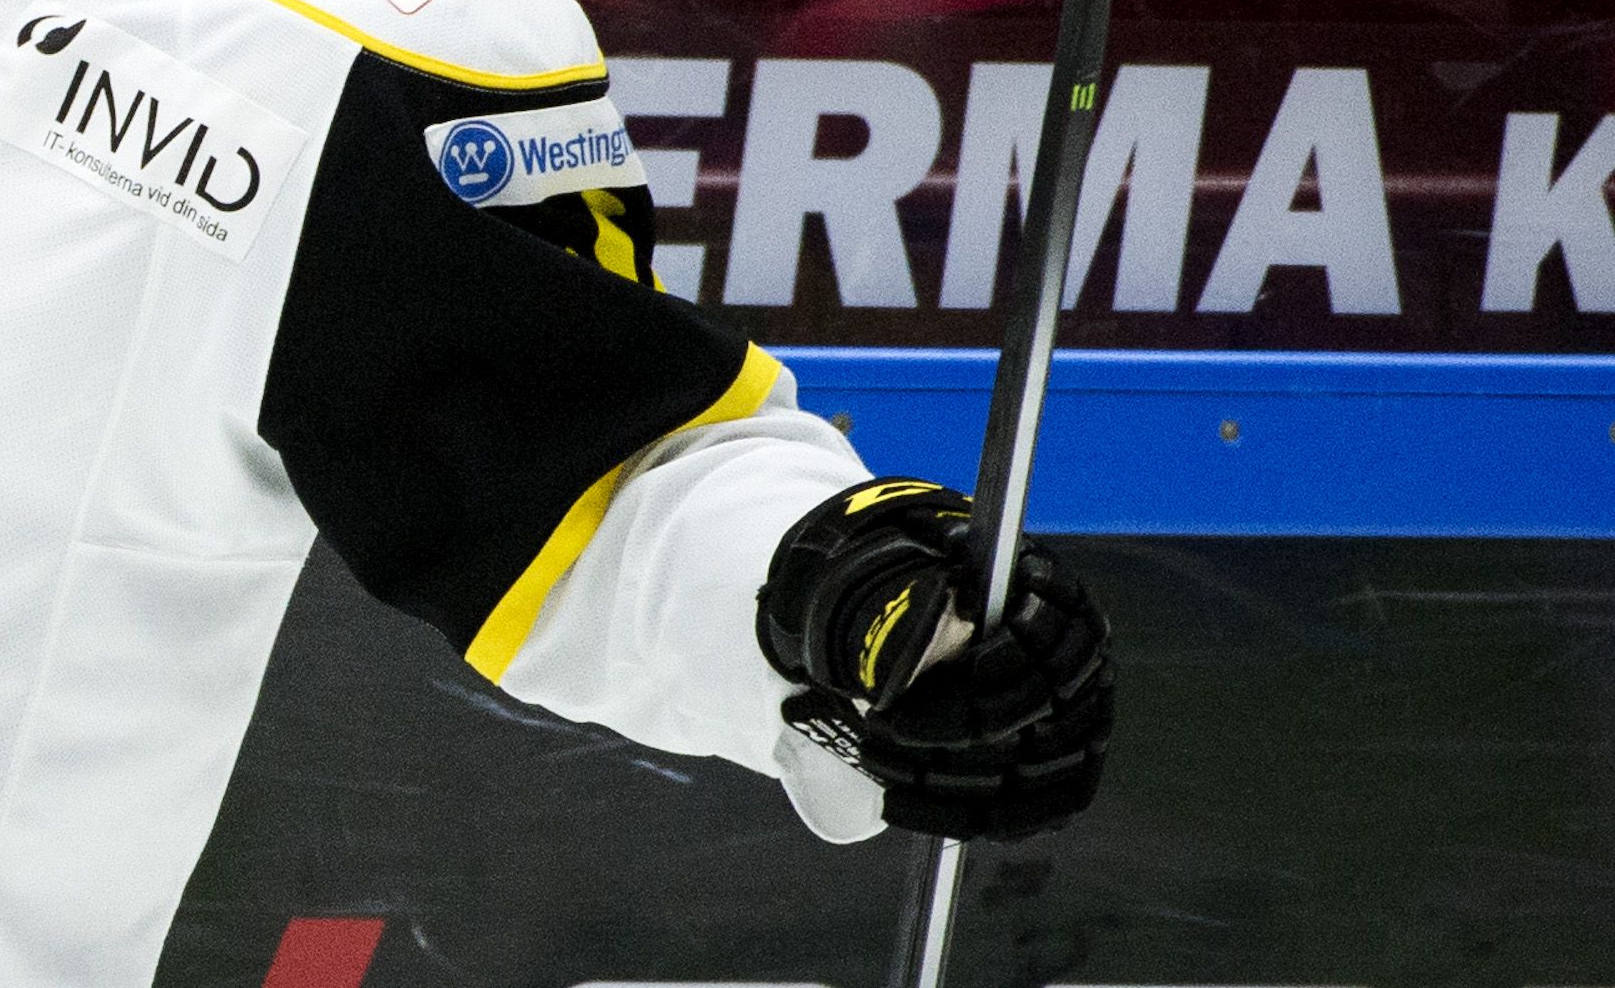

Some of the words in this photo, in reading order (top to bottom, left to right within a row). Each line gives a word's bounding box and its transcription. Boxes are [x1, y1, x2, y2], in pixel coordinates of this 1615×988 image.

[43, 130, 144, 197] IT-konsulterna
[148, 185, 173, 208] vid
[172, 198, 197, 223] din
[196, 216, 229, 242] sida
[54, 60, 261, 213] INVID
